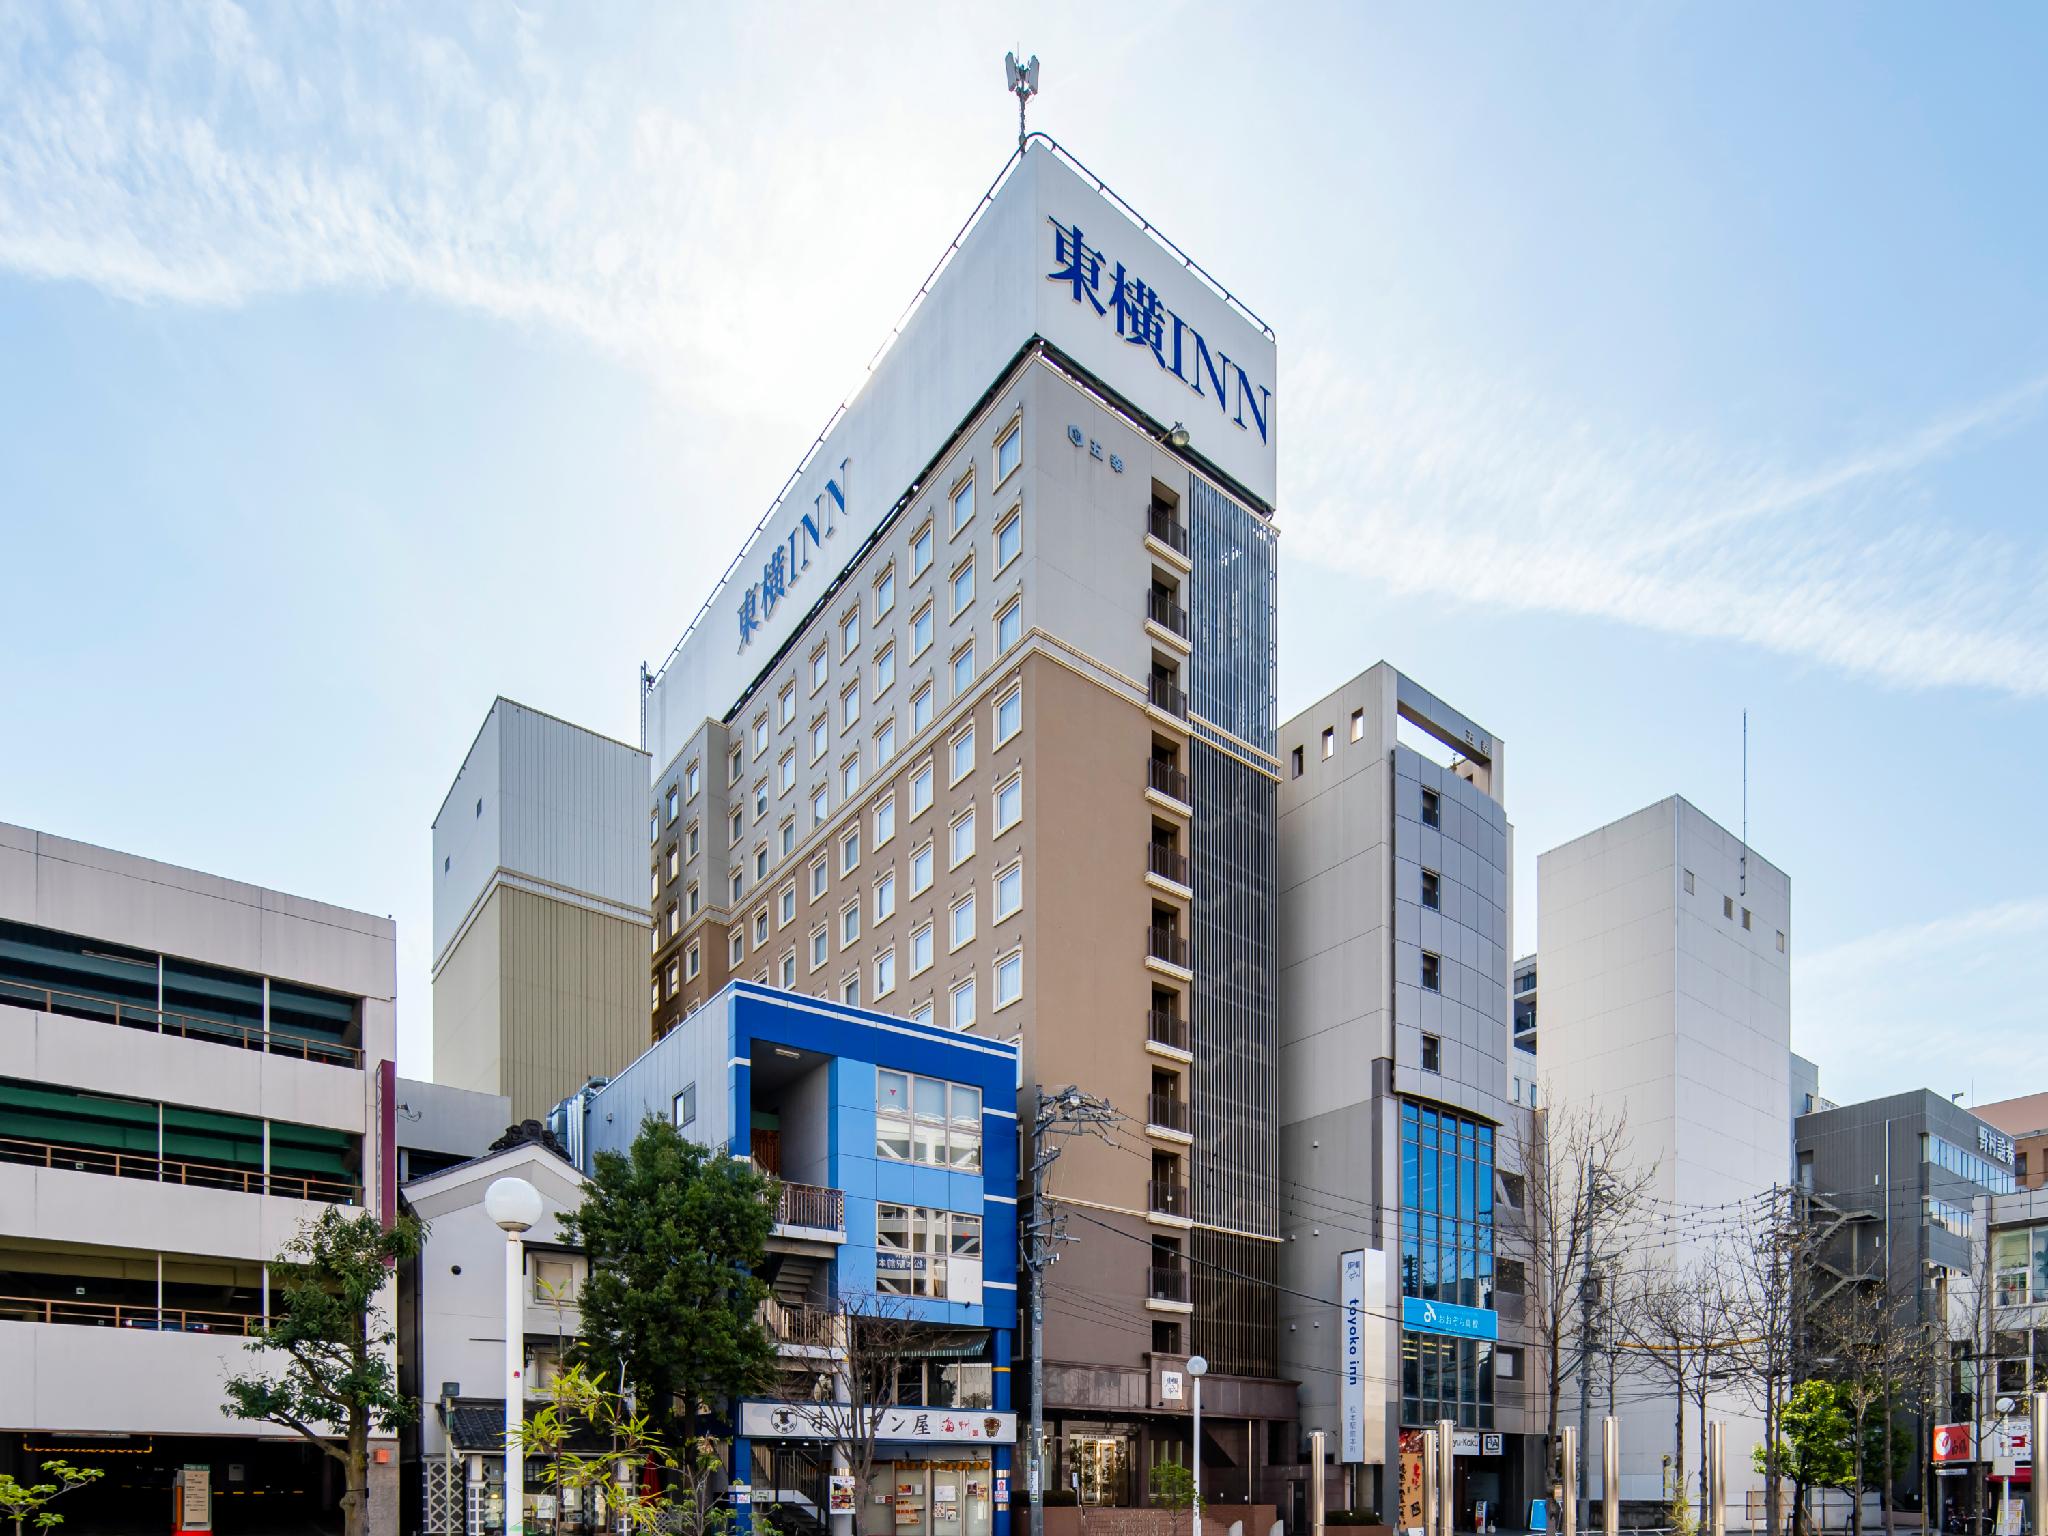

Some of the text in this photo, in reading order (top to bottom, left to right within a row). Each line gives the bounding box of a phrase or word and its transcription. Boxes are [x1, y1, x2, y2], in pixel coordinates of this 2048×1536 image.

[1046, 214, 1272, 446] 東横INN
[737, 457, 849, 655] 東横INN
[1343, 1298, 1360, 1355] toyoko
[1349, 1360, 1360, 1386] inn
